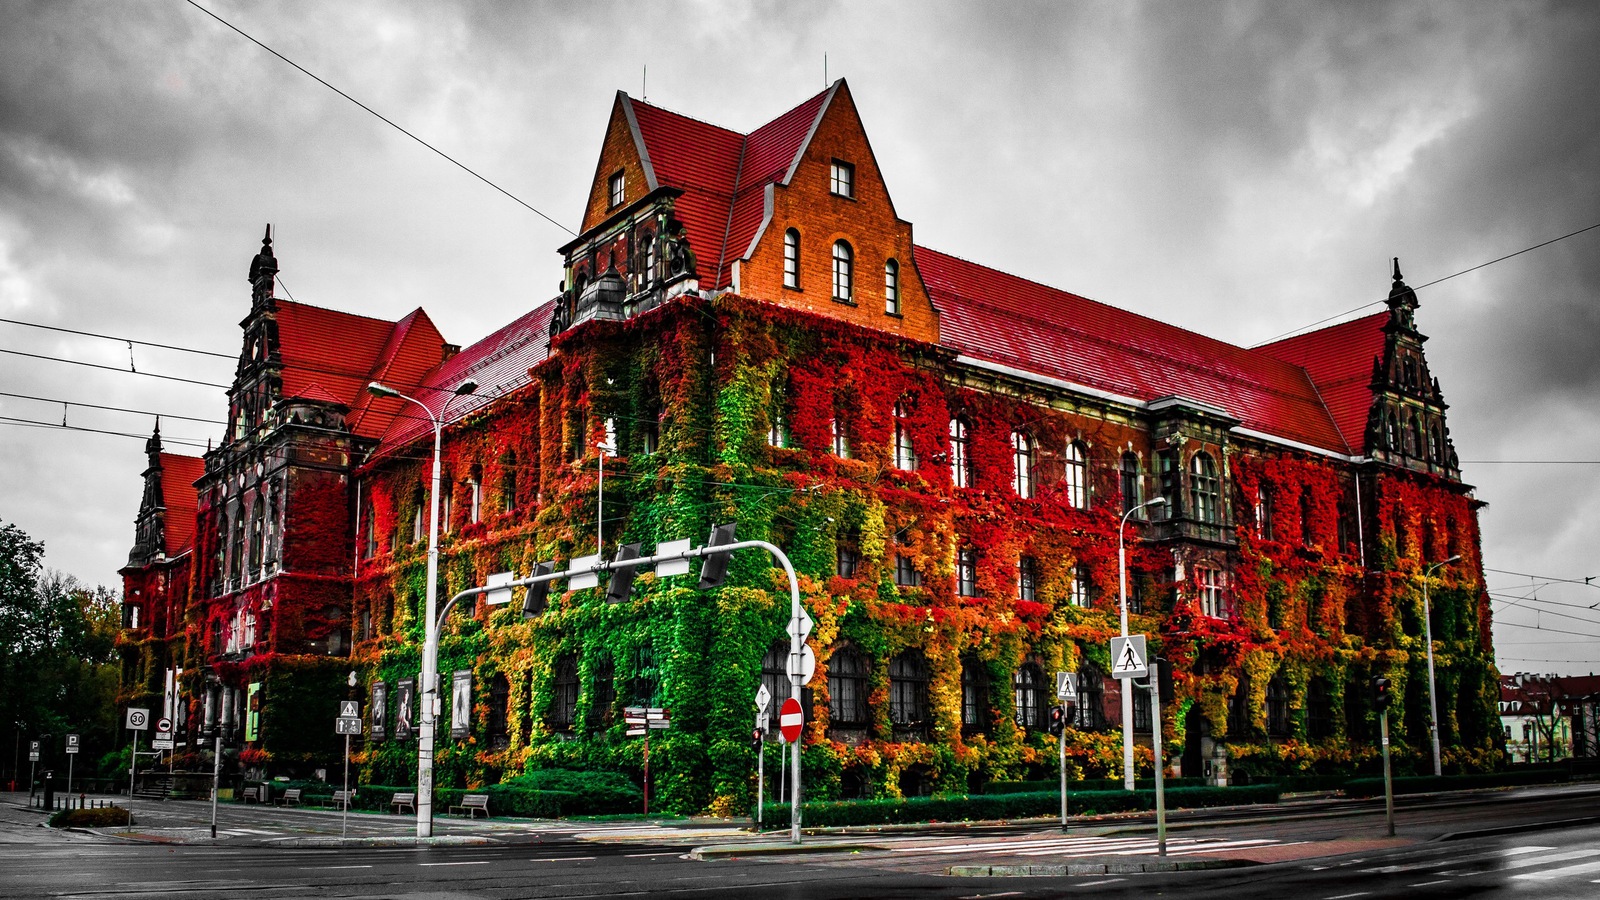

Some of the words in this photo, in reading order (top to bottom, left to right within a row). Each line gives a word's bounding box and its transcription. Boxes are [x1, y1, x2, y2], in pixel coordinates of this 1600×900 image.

[132, 715, 144, 723] 30
[68, 736, 77, 746] P
[32, 742, 39, 750] P
